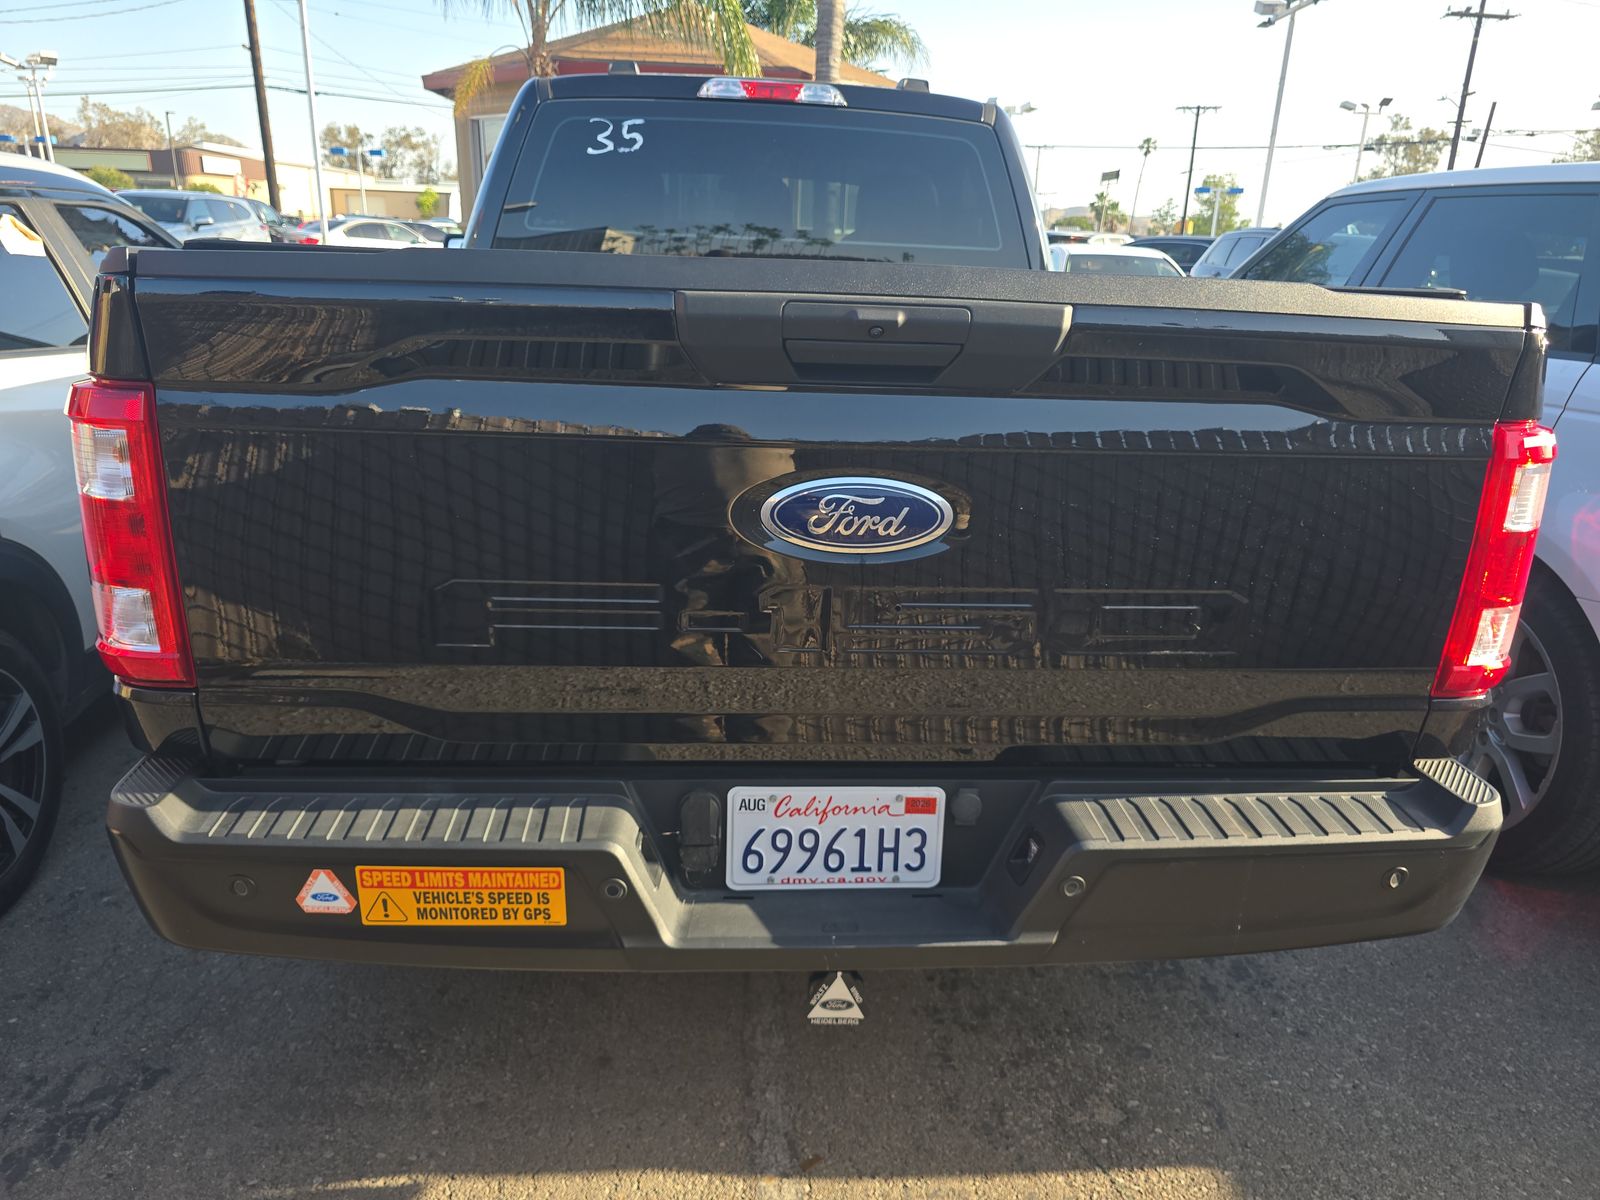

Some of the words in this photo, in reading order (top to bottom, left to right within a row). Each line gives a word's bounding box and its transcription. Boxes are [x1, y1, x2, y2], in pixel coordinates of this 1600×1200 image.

[586, 117, 645, 155] 35
[807, 494, 911, 537] Ford
[739, 798, 766, 811] AUG
[773, 795, 905, 825] California
[741, 827, 928, 874] 69961H3
[362, 871, 411, 887] SPEED
[415, 872, 464, 888] LIMITS
[468, 872, 561, 889] MAINTAINED
[780, 876, 888, 885] dmv.ca.gov
[413, 891, 486, 905] VEHICLE'S
[488, 892, 534, 905] SPEED
[537, 892, 550, 905] IS
[416, 908, 499, 920] MONITORED
[502, 908, 520, 921] BY
[523, 908, 552, 921] GPS
